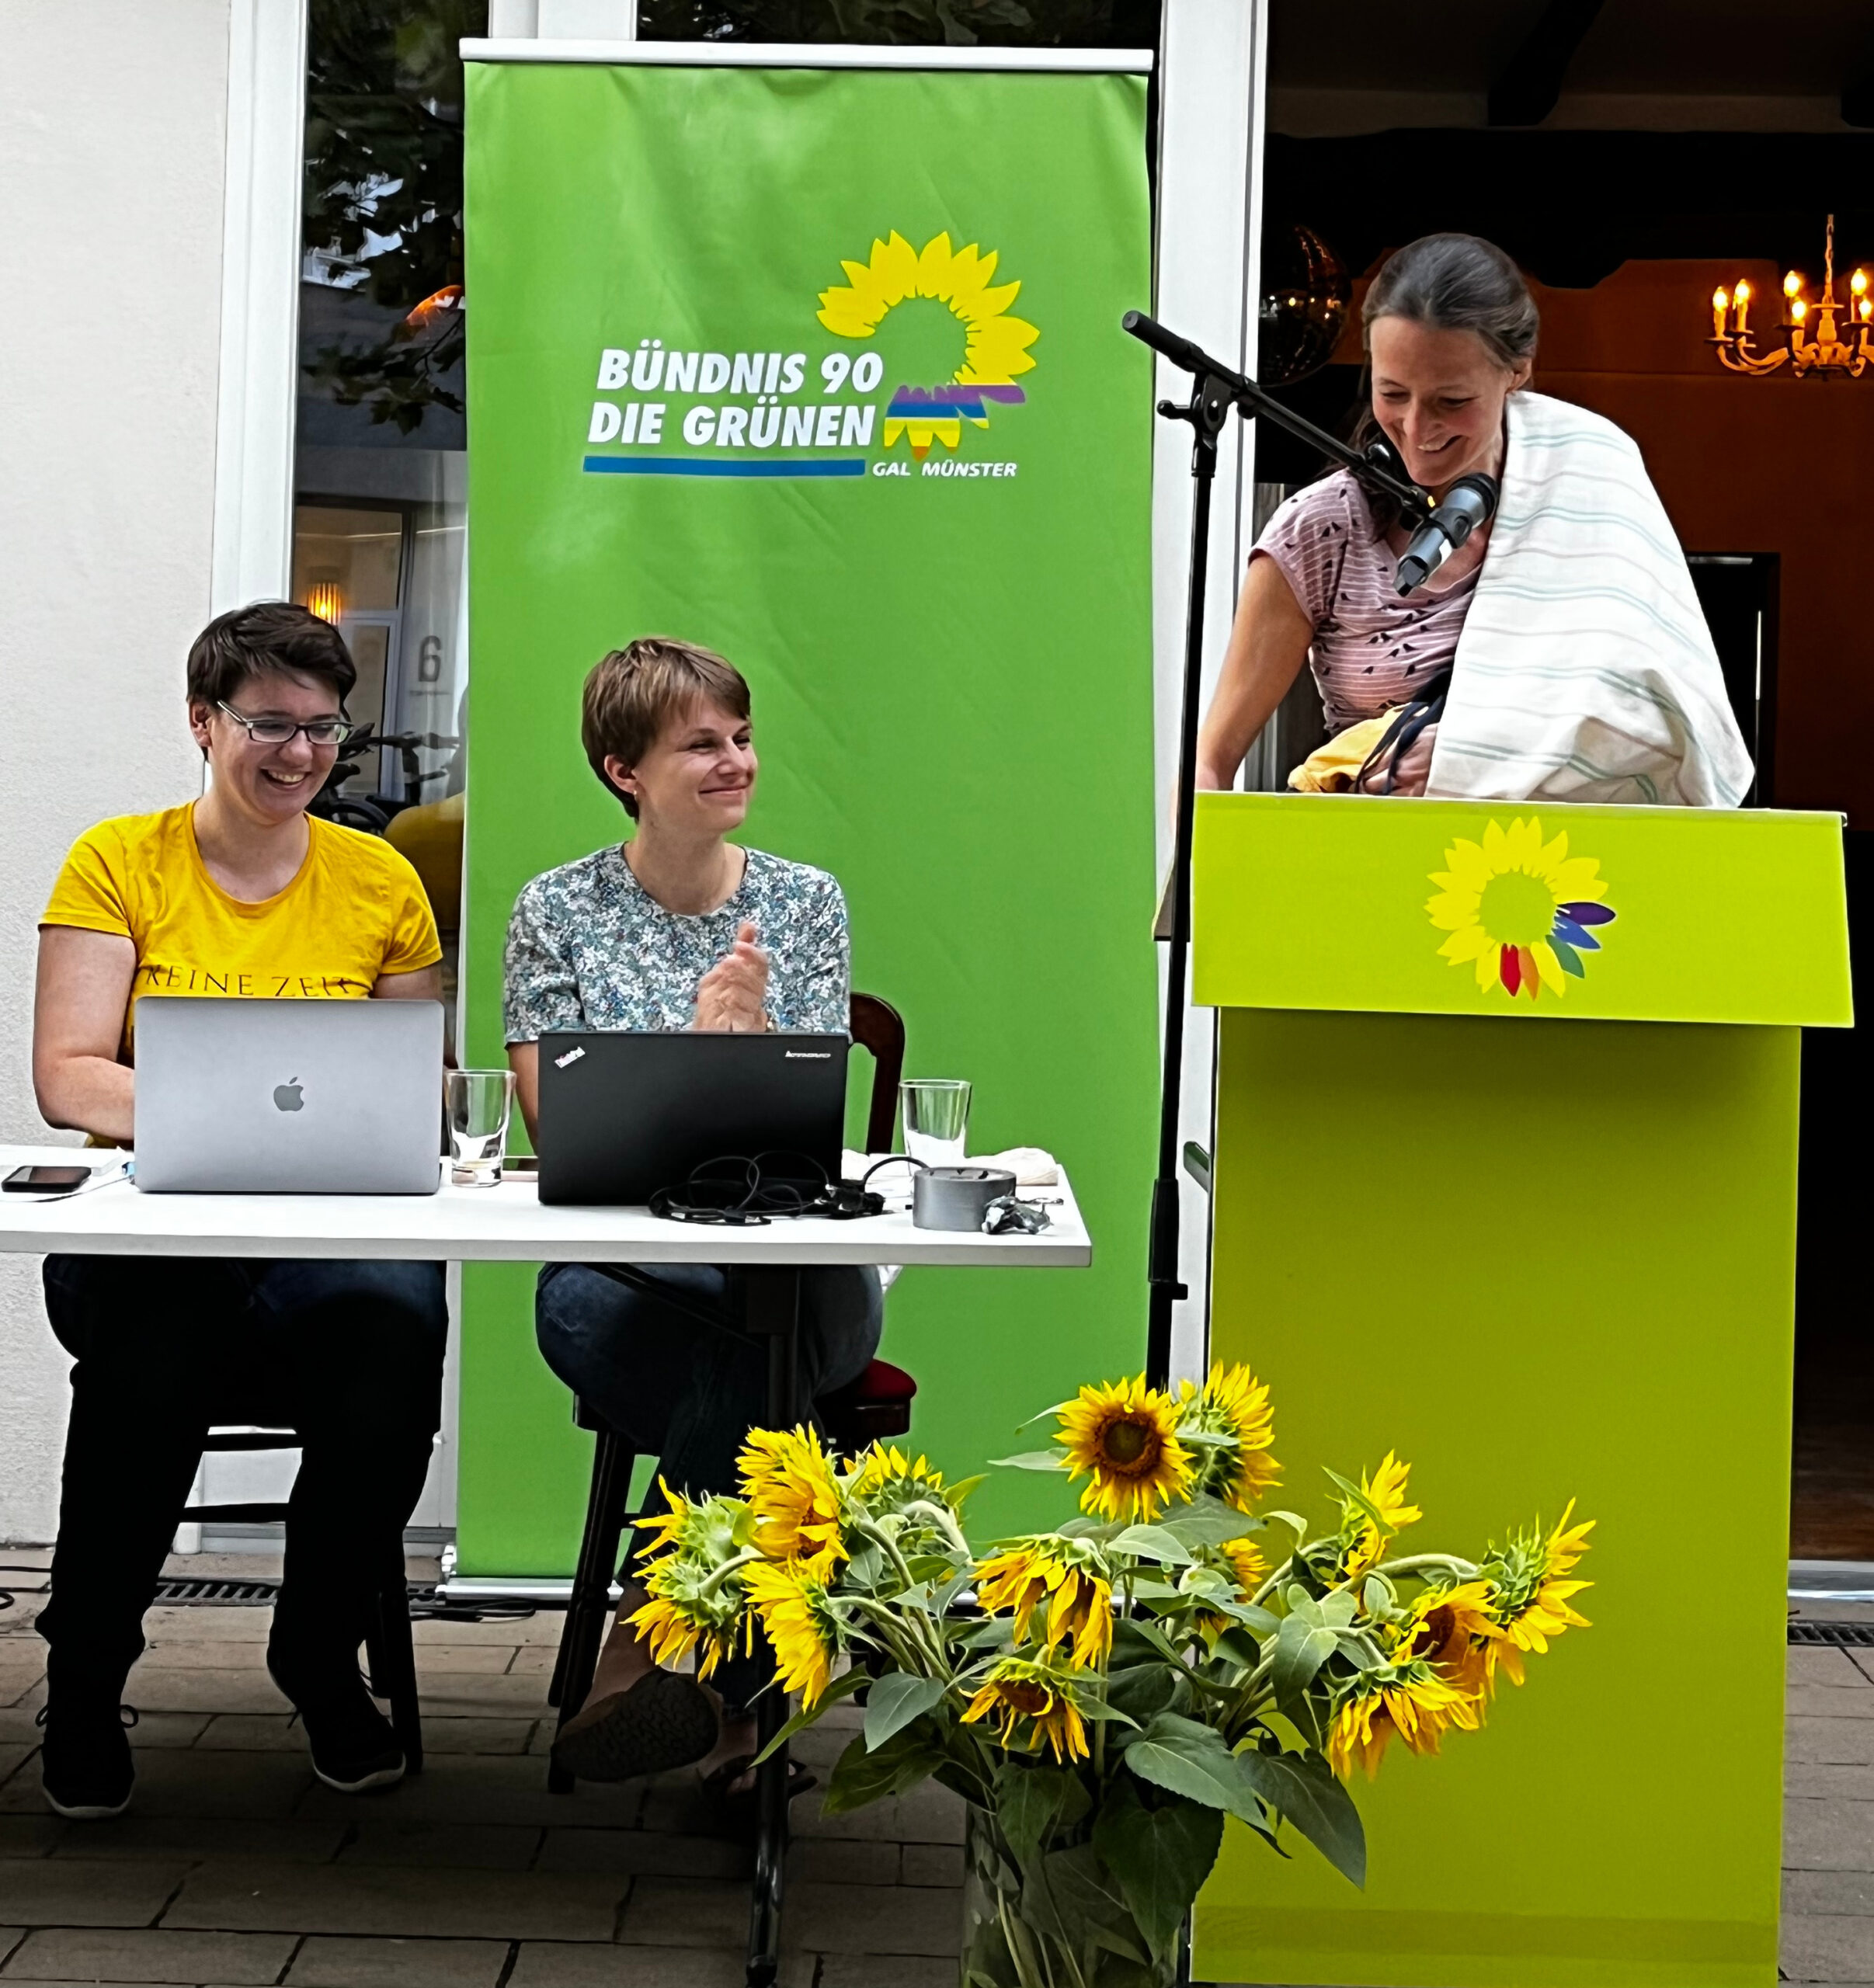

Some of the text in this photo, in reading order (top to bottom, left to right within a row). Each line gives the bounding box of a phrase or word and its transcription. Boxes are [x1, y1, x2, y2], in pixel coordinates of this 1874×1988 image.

[596, 339, 883, 394] BÜNDNIS 90
[587, 395, 876, 448] DIE GRÜNEN
[872, 458, 1017, 477] GAL MÜNSTER
